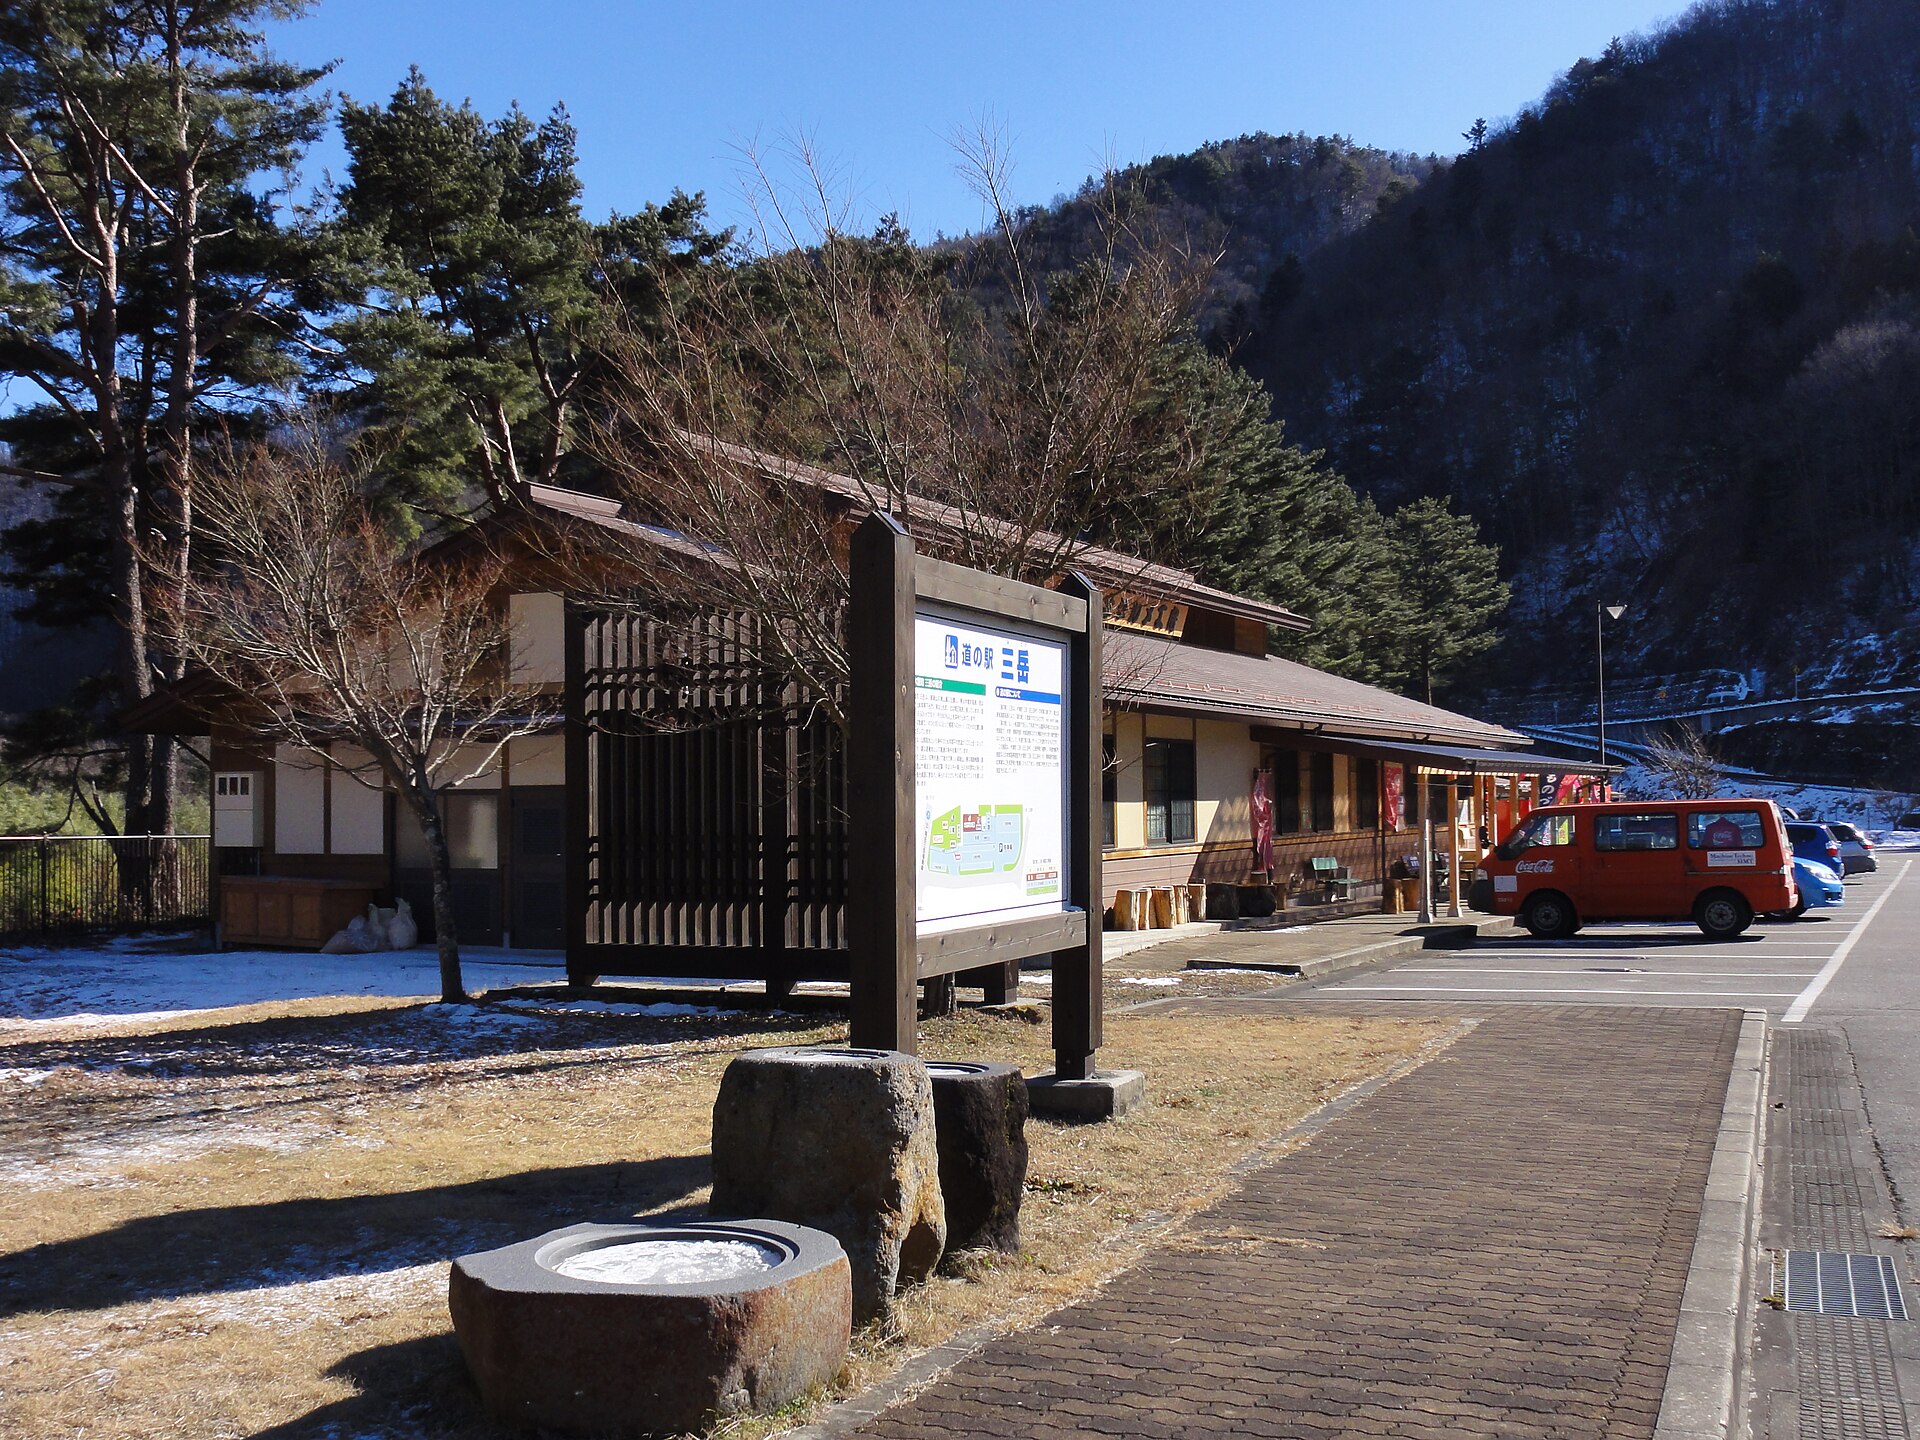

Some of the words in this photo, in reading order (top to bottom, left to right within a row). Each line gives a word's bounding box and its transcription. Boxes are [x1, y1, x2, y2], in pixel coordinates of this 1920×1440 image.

[961, 643, 994, 669] 道の駅
[1001, 647, 1030, 684] 三岳
[1515, 859, 1554, 873] Coca-Cola
